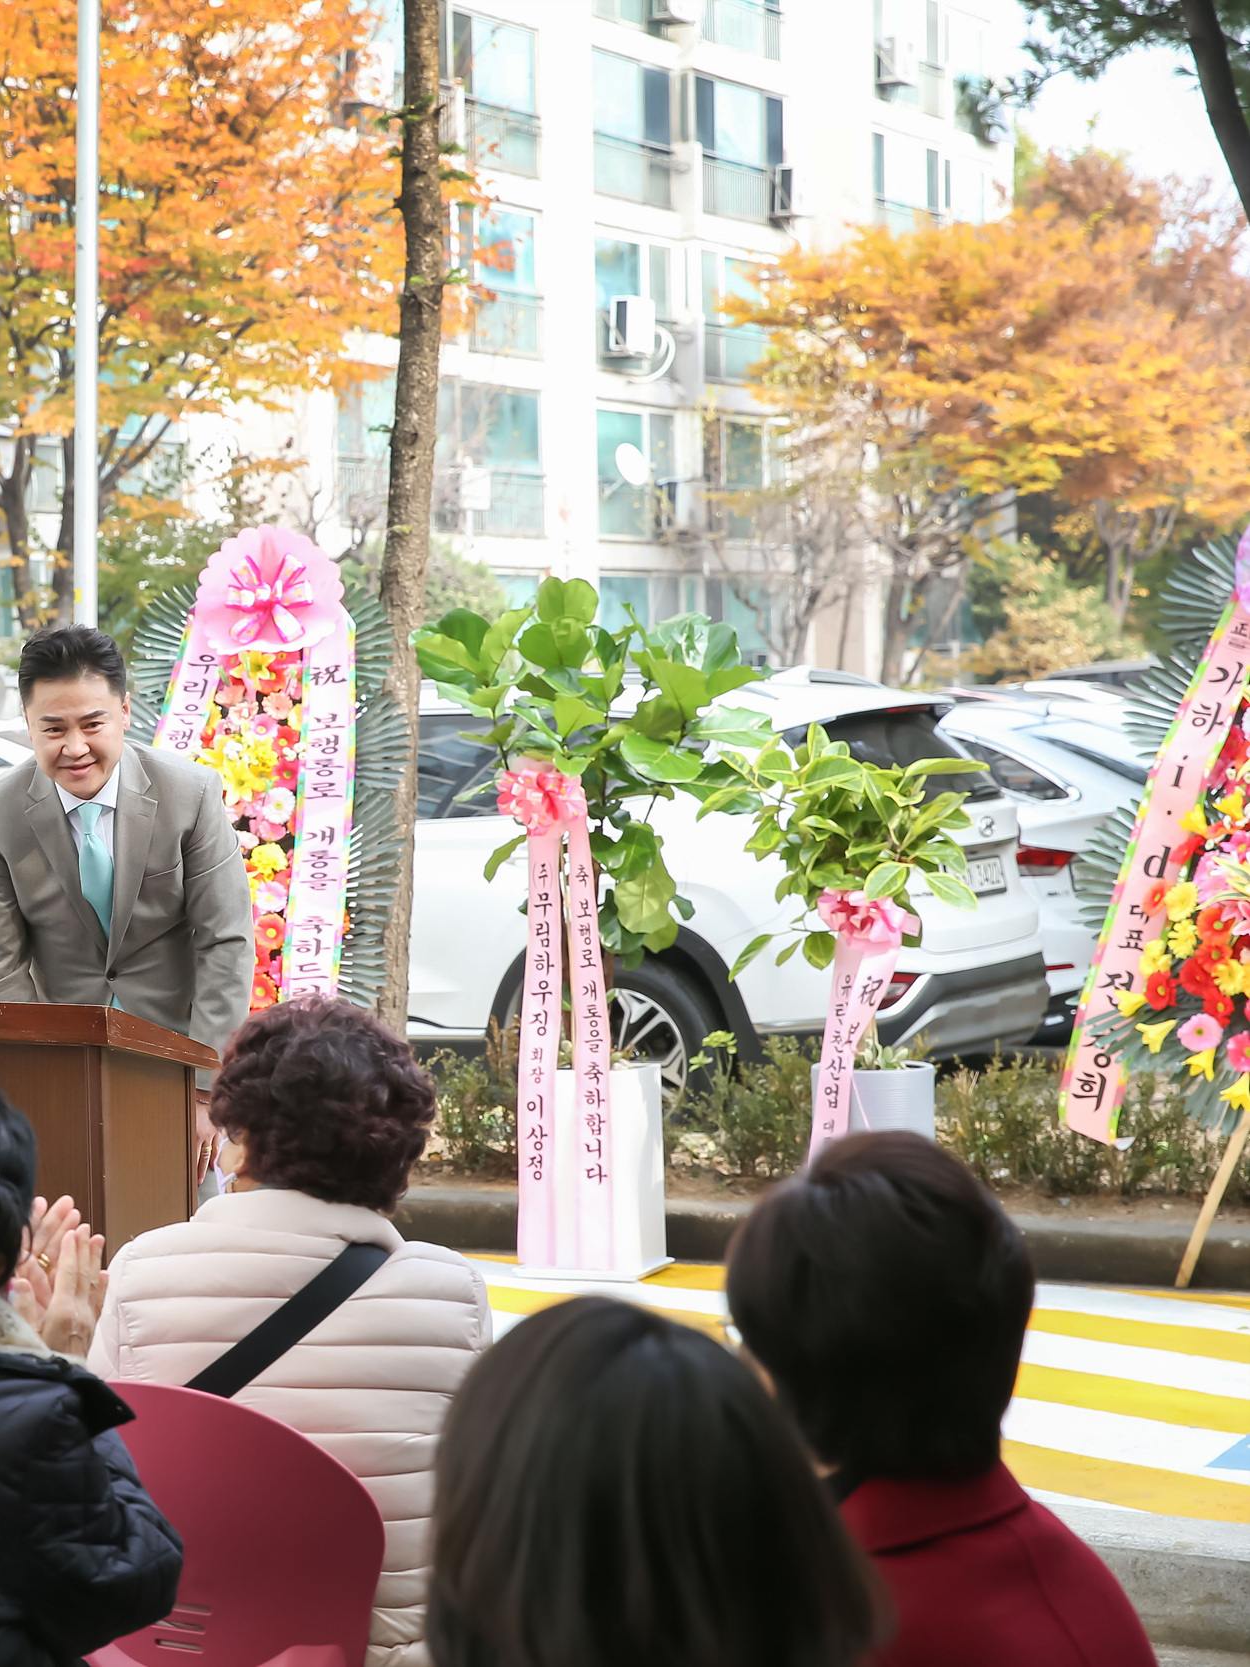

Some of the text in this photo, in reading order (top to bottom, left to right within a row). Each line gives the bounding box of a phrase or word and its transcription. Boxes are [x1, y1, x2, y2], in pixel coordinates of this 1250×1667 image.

[167, 654, 218, 750] 우리은행
[309, 664, 347, 686] 祝
[303, 713, 346, 801] 보행통로
[299, 826, 339, 891] 개통을
[526, 861, 555, 1181] (주)무림하우징 회장 이상정
[575, 864, 608, 1185] 축 보행로 개통을 축하합니다
[1072, 970, 1134, 1112] 전희
